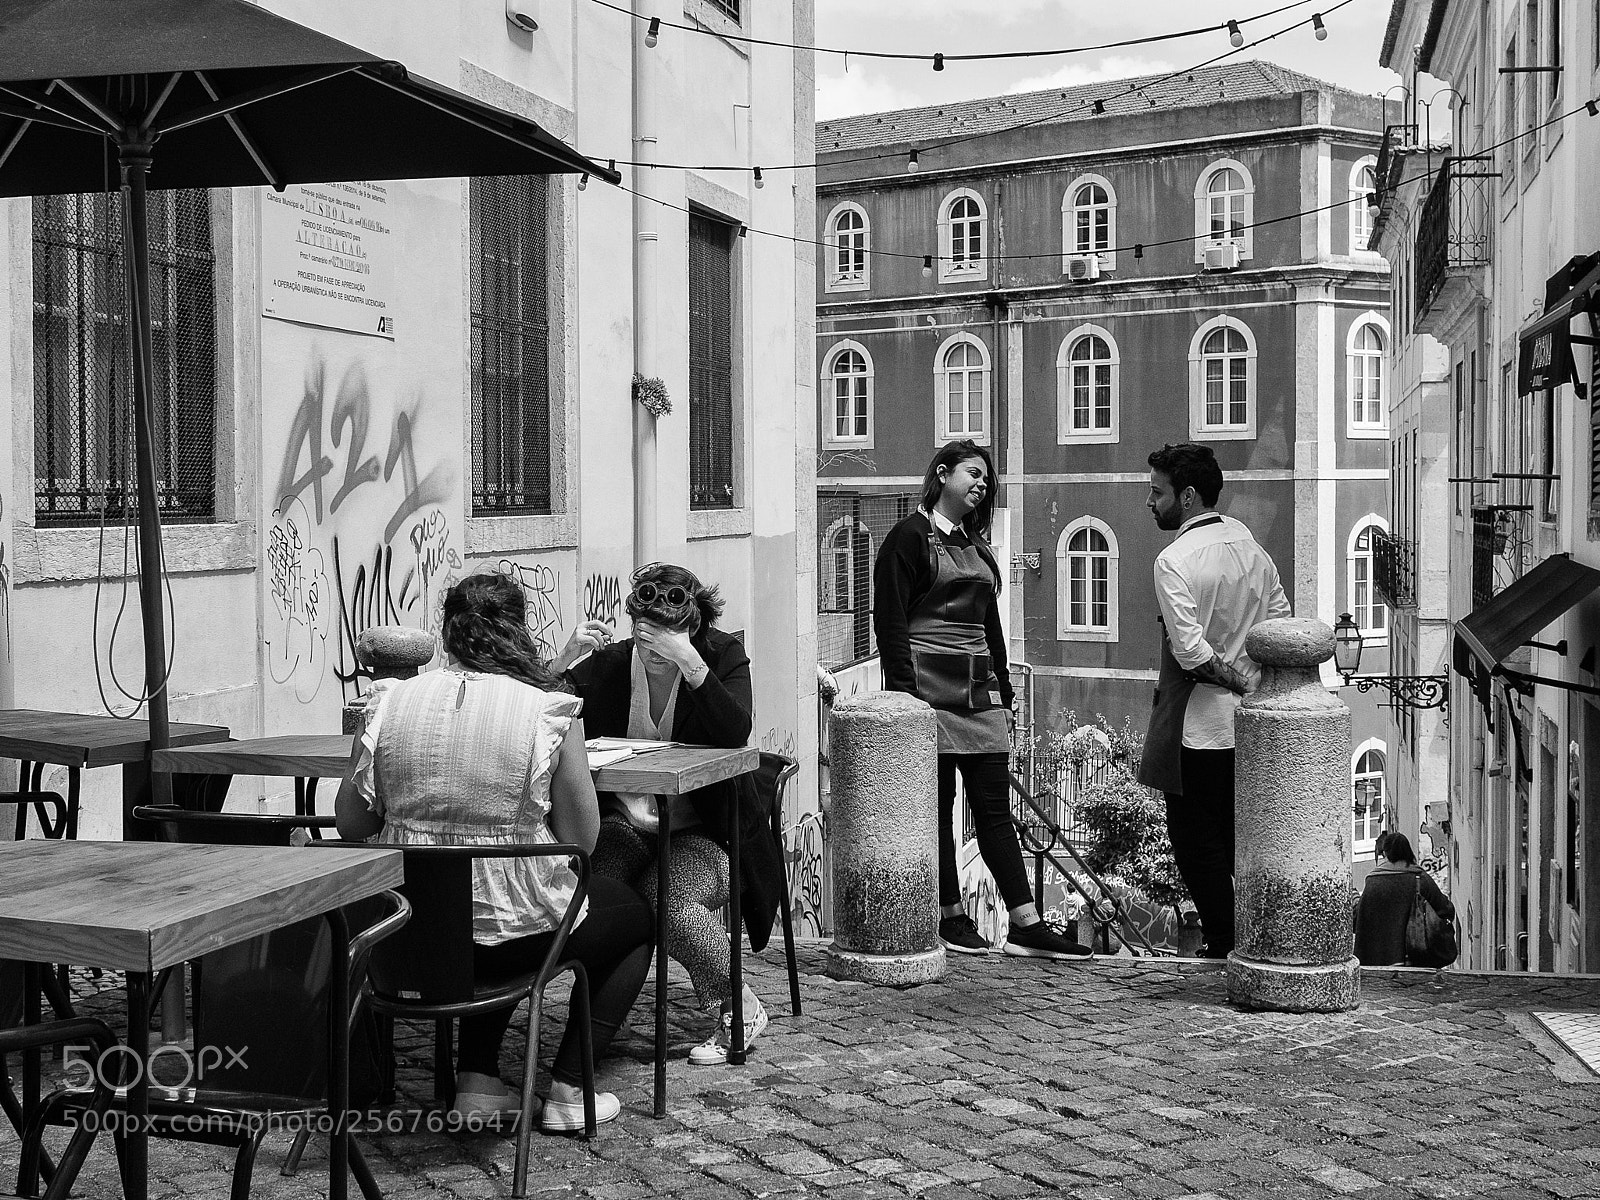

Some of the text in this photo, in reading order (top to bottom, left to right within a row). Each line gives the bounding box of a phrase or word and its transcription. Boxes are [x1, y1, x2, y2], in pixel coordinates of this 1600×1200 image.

[301, 219, 316, 230] PEDIDO
[316, 223, 322, 231] DE
[297, 270, 366, 293] PROJETO EM FASE DE APRECIAÇÃO
[277, 280, 301, 292] OPERAÇÃO
[328, 289, 337, 300] NÃO
[337, 292, 344, 301] SE
[344, 293, 365, 305] ENCONTRA
[365, 299, 386, 309] LICENCIADA
